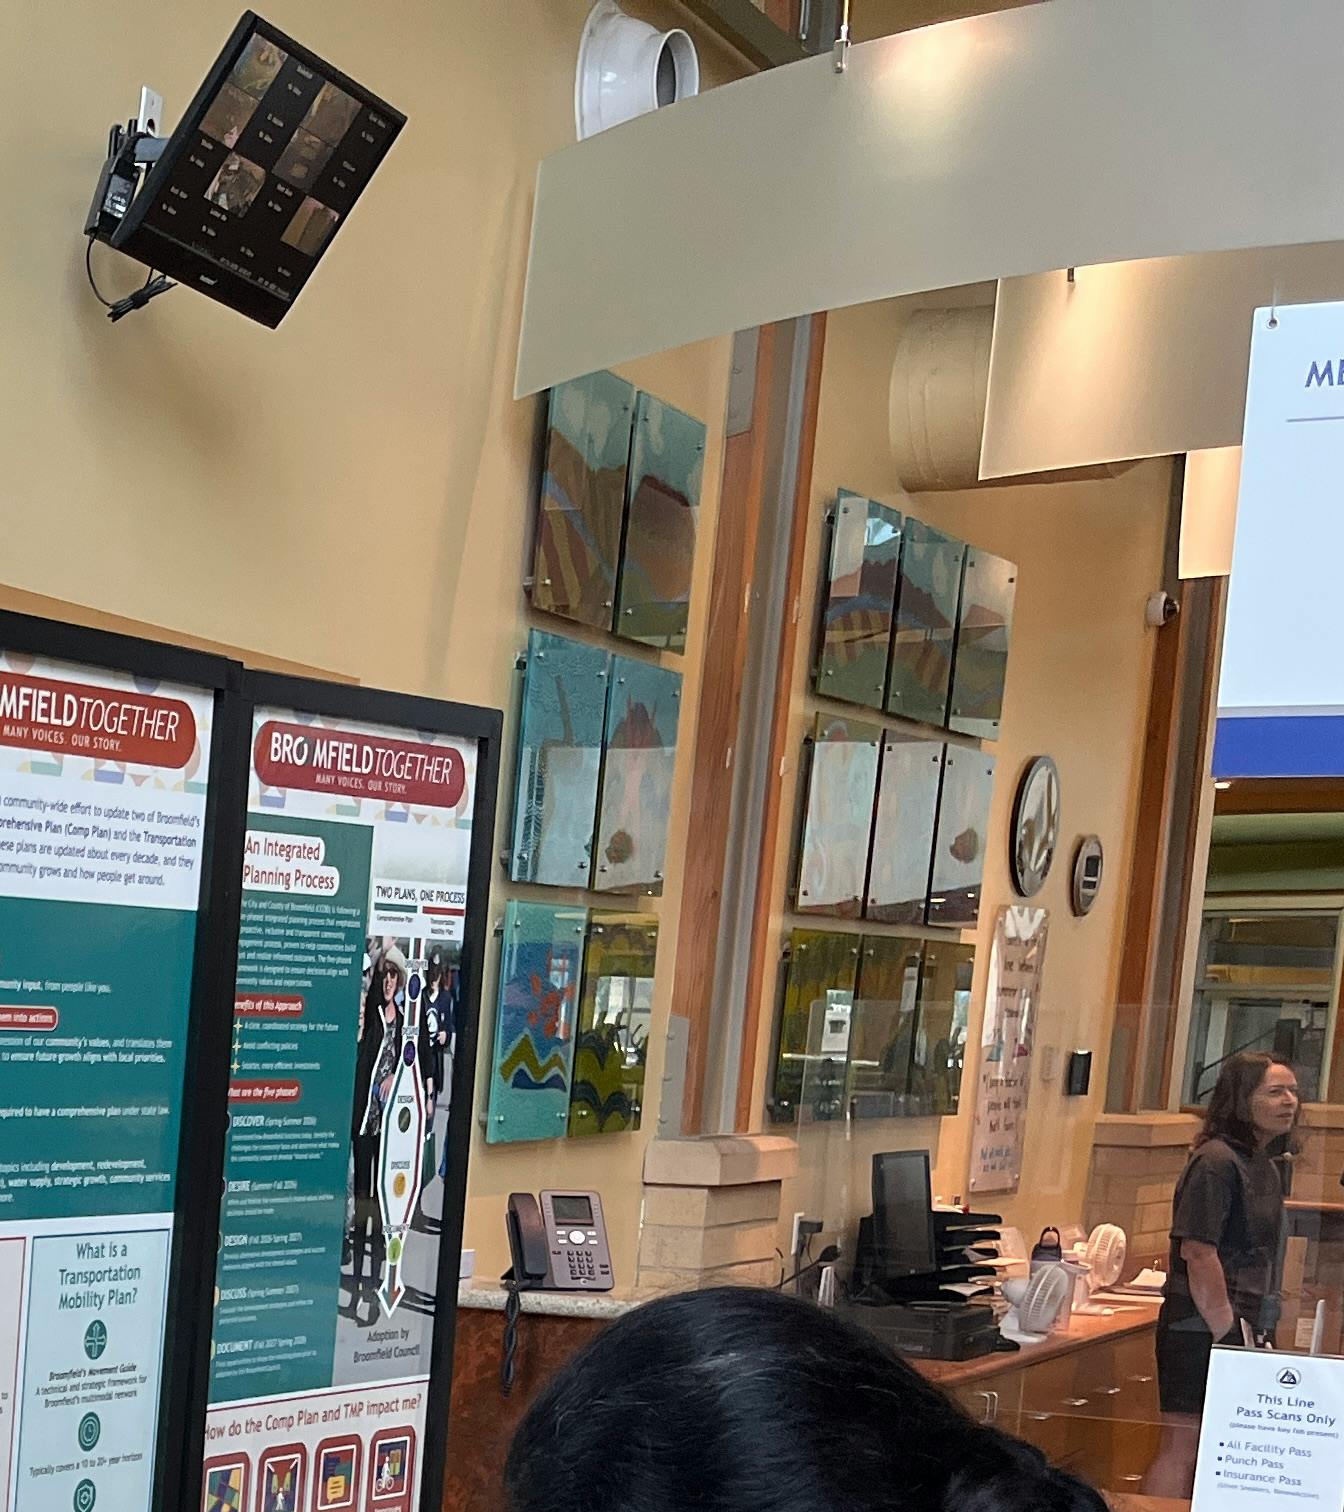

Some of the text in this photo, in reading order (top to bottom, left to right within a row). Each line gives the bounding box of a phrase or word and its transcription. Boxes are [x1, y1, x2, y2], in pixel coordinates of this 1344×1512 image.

[2, 725, 29, 738] MANY
[71, 734, 90, 747] OUR
[92, 736, 121, 751] STORY.
[315, 773, 407, 794] MANY VOICES. OUR STORY.
[44, 821, 63, 834] Plan
[64, 823, 90, 839] (Comp
[91, 825, 112, 841] Plan)
[113, 830, 128, 841] and
[128, 830, 141, 843] the
[143, 830, 197, 848] Transportation
[244, 835, 322, 862] An Integrated
[38, 866, 62, 879] grows
[62, 867, 78, 879] and
[79, 867, 96, 880] how
[96, 871, 123, 883] people
[123, 873, 136, 886] get
[137, 874, 165, 886] around.
[243, 864, 336, 890] Planning Process
[375, 885, 465, 904] TWO PLANS, ONE PROCESS
[76, 1241, 128, 1259] What is a
[58, 1266, 141, 1287] Transportation
[58, 1287, 138, 1310] Mobility Plan?
[366, 1327, 410, 1343] Adoption by
[353, 1347, 393, 1363] Broomfield
[1257, 1393, 1315, 1409] This Line
[228, 1420, 242, 1437] do
[244, 1418, 263, 1434] the
[265, 1414, 295, 1432] Comp
[296, 1410, 319, 1426] Plan
[321, 1405, 341, 1423] and
[343, 1401, 364, 1418] TMP
[366, 1399, 400, 1417] impact
[401, 1393, 422, 1410] me?
[1236, 1406, 1336, 1427] Pass Scans Only
[1226, 1440, 1312, 1458] All Facility Pass
[1224, 1454, 1285, 1470] Punch Pass
[1223, 1470, 1302, 1486] Insurance Pass
